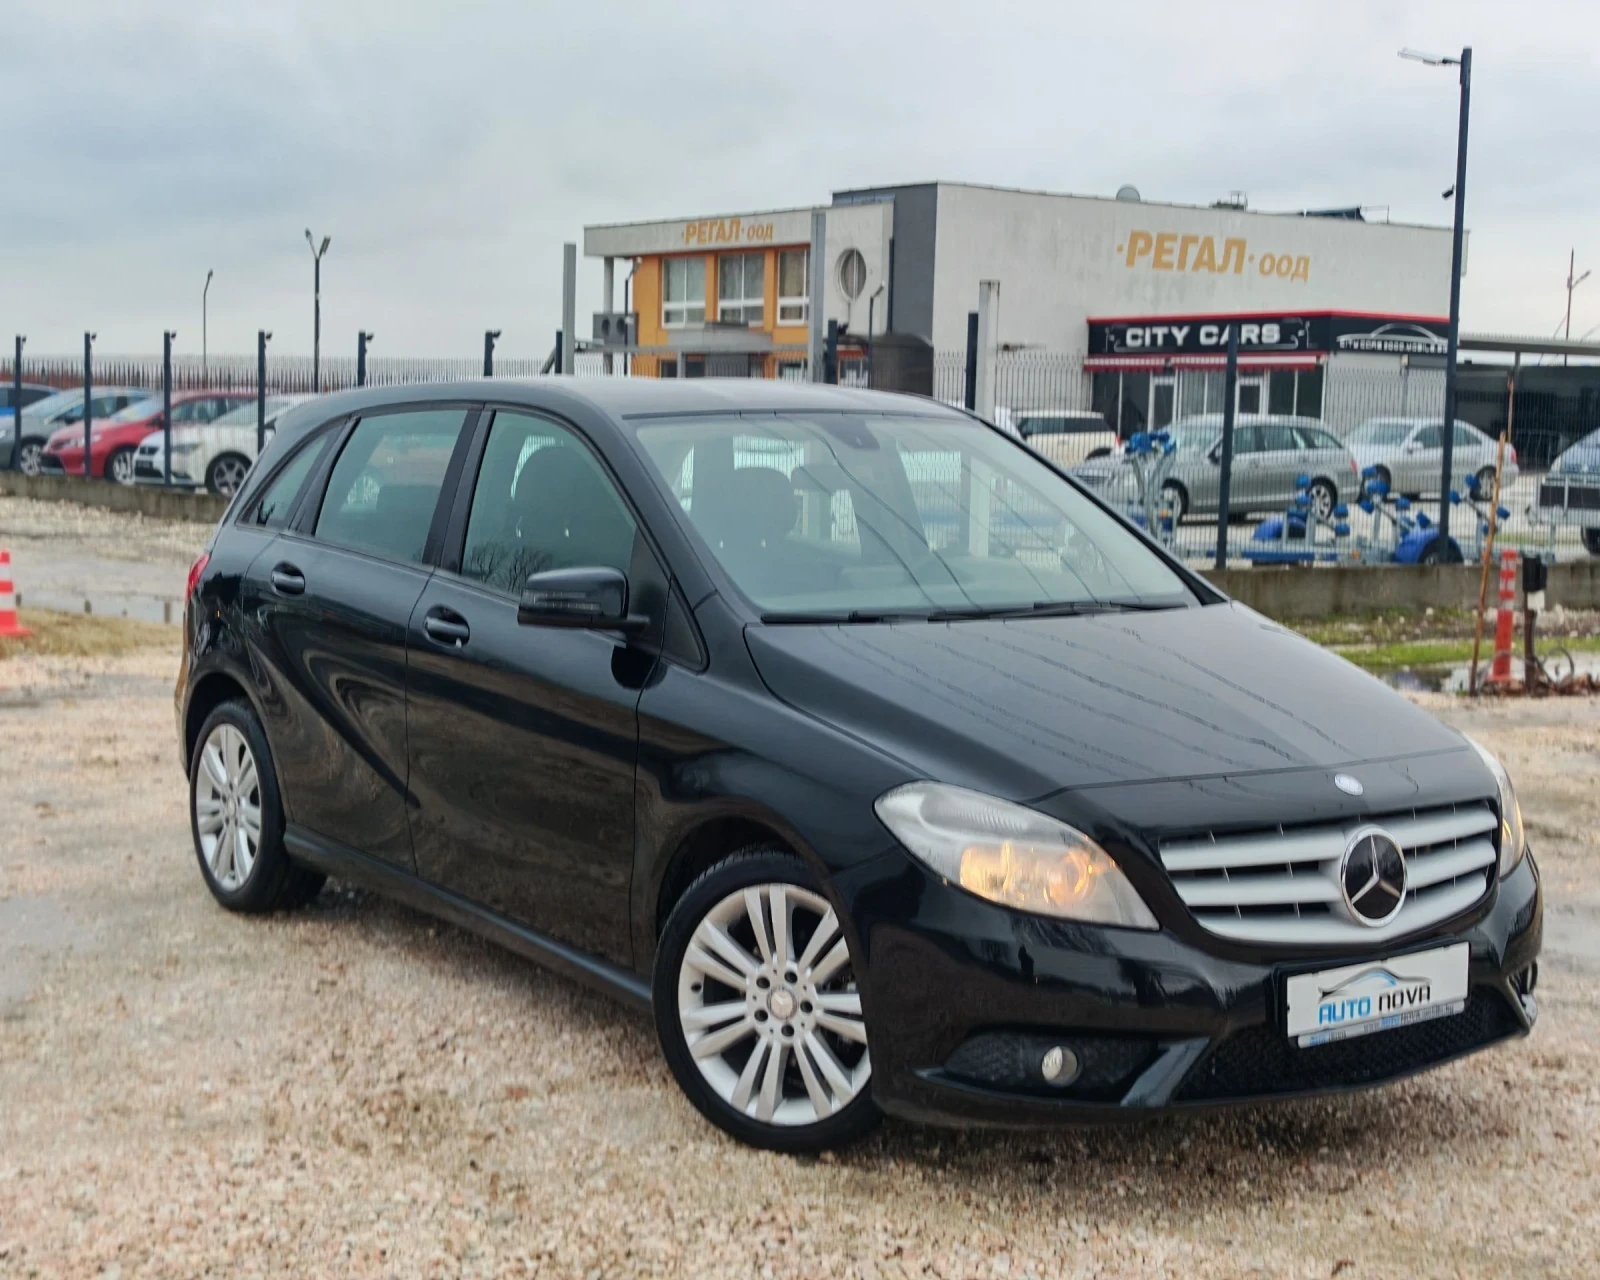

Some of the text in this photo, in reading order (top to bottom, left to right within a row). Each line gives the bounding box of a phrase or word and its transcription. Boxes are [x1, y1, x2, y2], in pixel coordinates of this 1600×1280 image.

[685, 217, 741, 245] РЕГАЛ
[1125, 229, 1247, 275] РЕГАЛ
[1126, 325, 1191, 348] CITY
[1318, 995, 1371, 1025] AUTO
